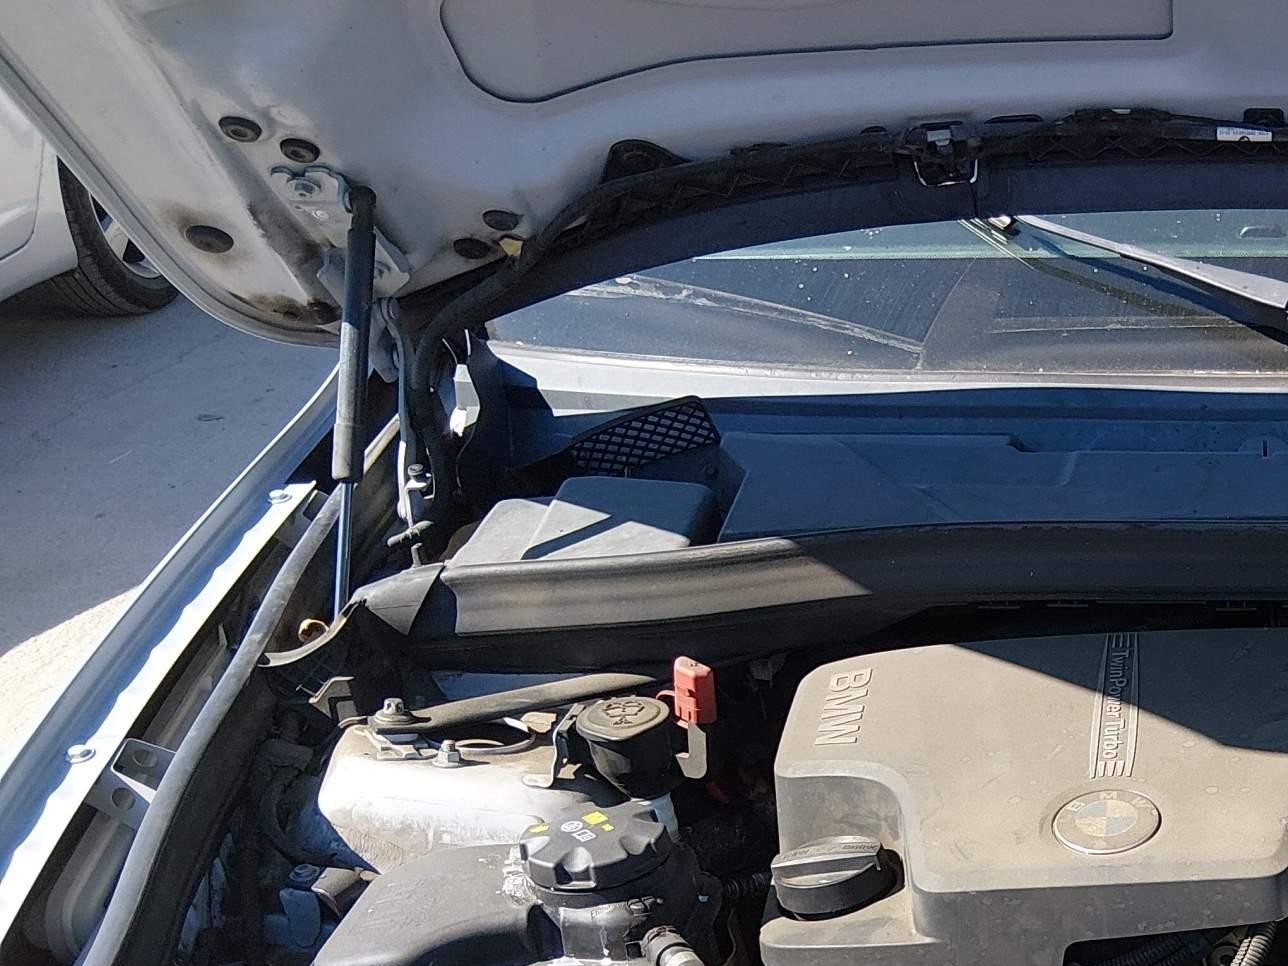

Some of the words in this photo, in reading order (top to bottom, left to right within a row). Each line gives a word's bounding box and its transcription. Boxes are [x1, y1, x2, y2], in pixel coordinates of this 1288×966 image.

[814, 667, 873, 745] BMW
[1106, 649, 1130, 718] TwinPower
[1103, 716, 1127, 760] Turbo
